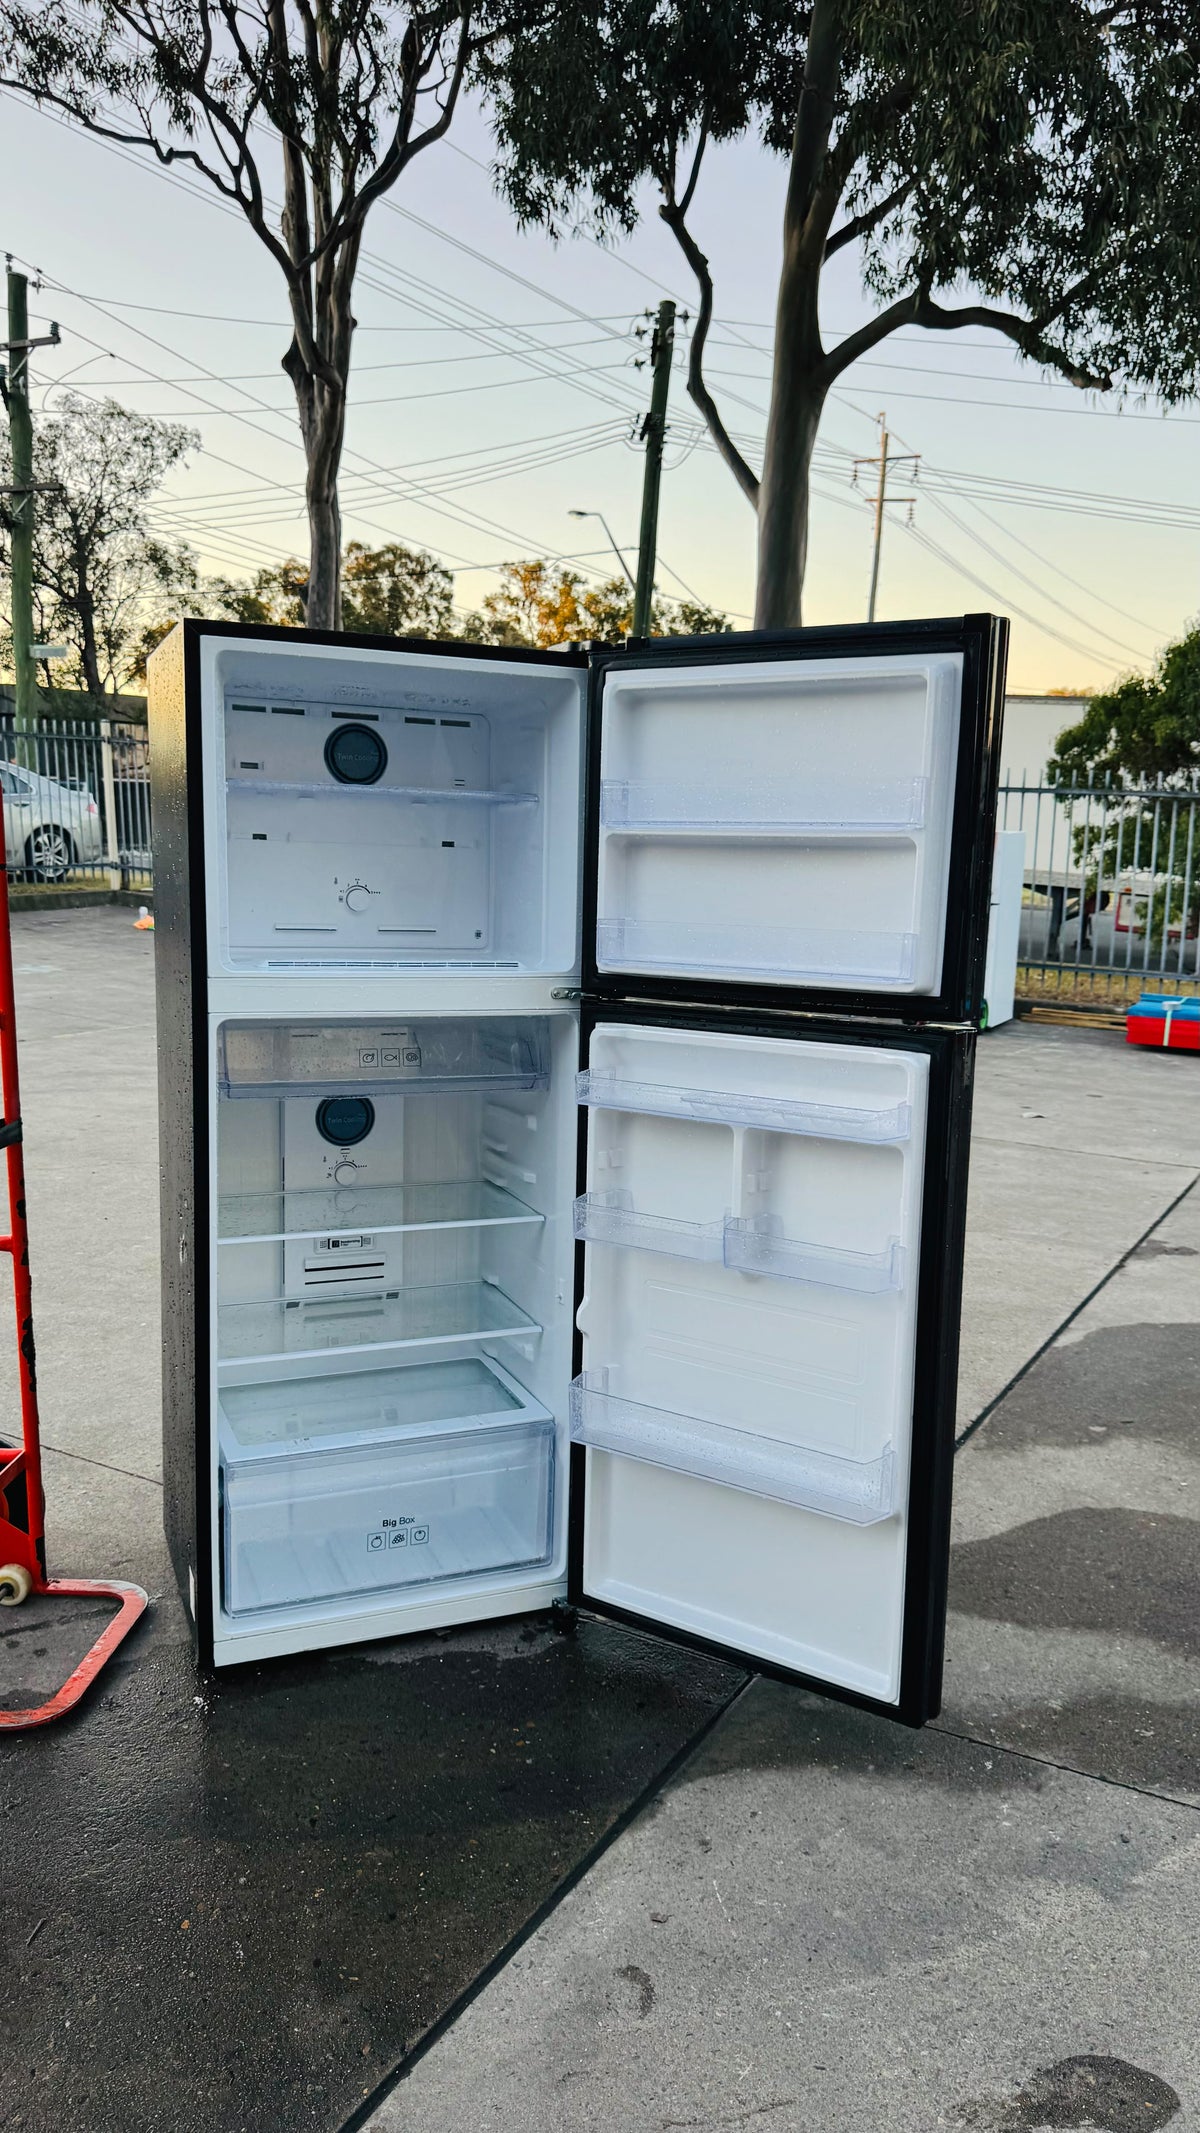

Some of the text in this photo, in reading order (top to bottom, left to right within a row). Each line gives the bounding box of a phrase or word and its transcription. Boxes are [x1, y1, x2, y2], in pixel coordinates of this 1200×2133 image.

[337, 752, 354, 761] Twin
[382, 1517, 415, 1527] Big Box
